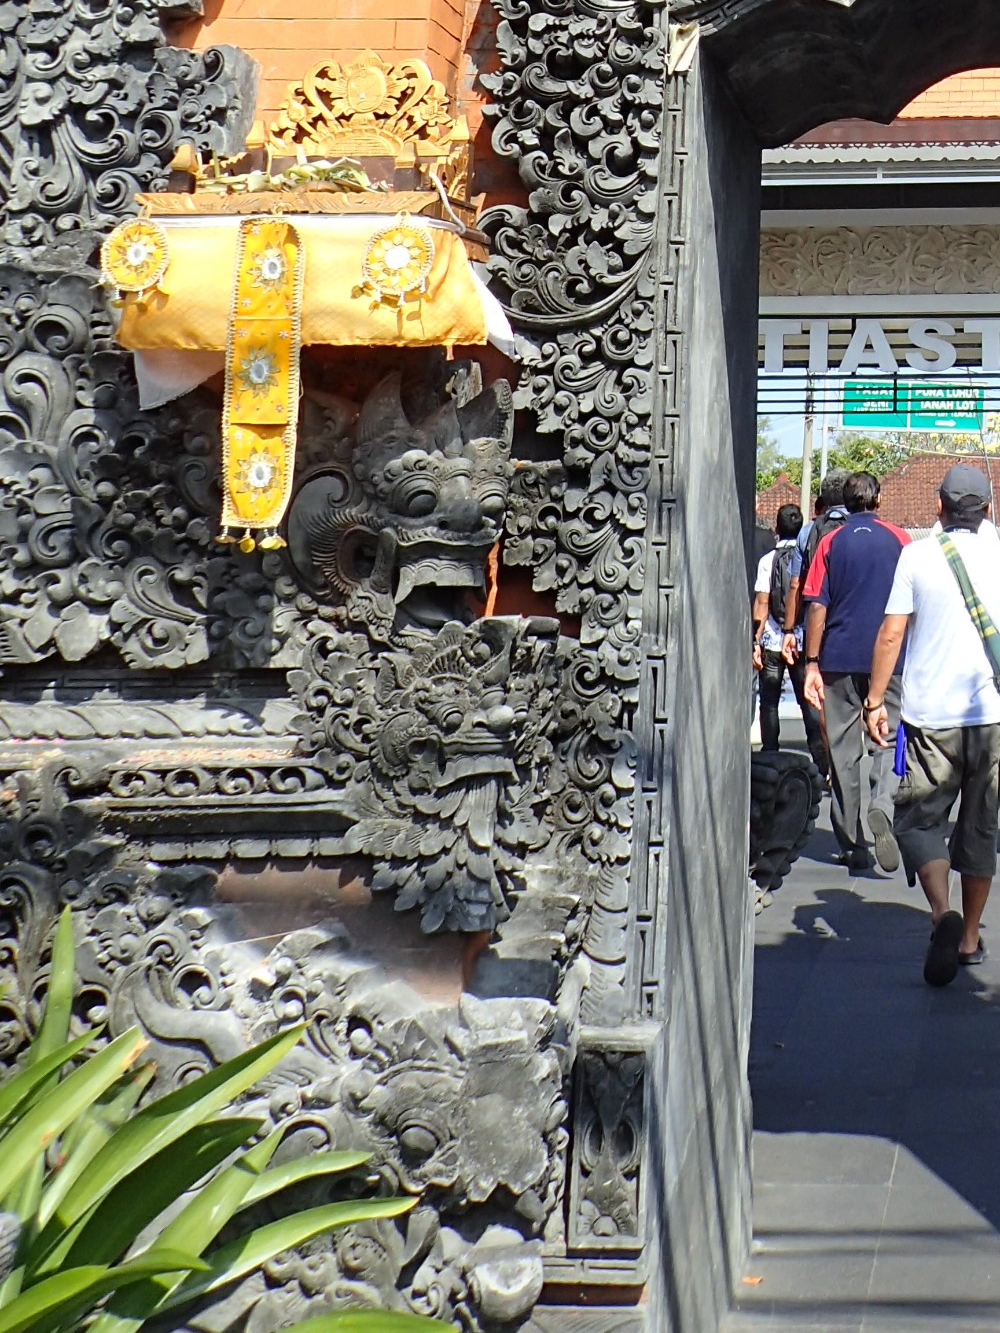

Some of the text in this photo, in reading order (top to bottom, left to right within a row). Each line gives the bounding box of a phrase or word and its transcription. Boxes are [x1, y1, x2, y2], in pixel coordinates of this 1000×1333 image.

[915, 388, 979, 398] PURA LUHUR
[863, 398, 889, 408] SENI
[955, 400, 975, 410] LOT
